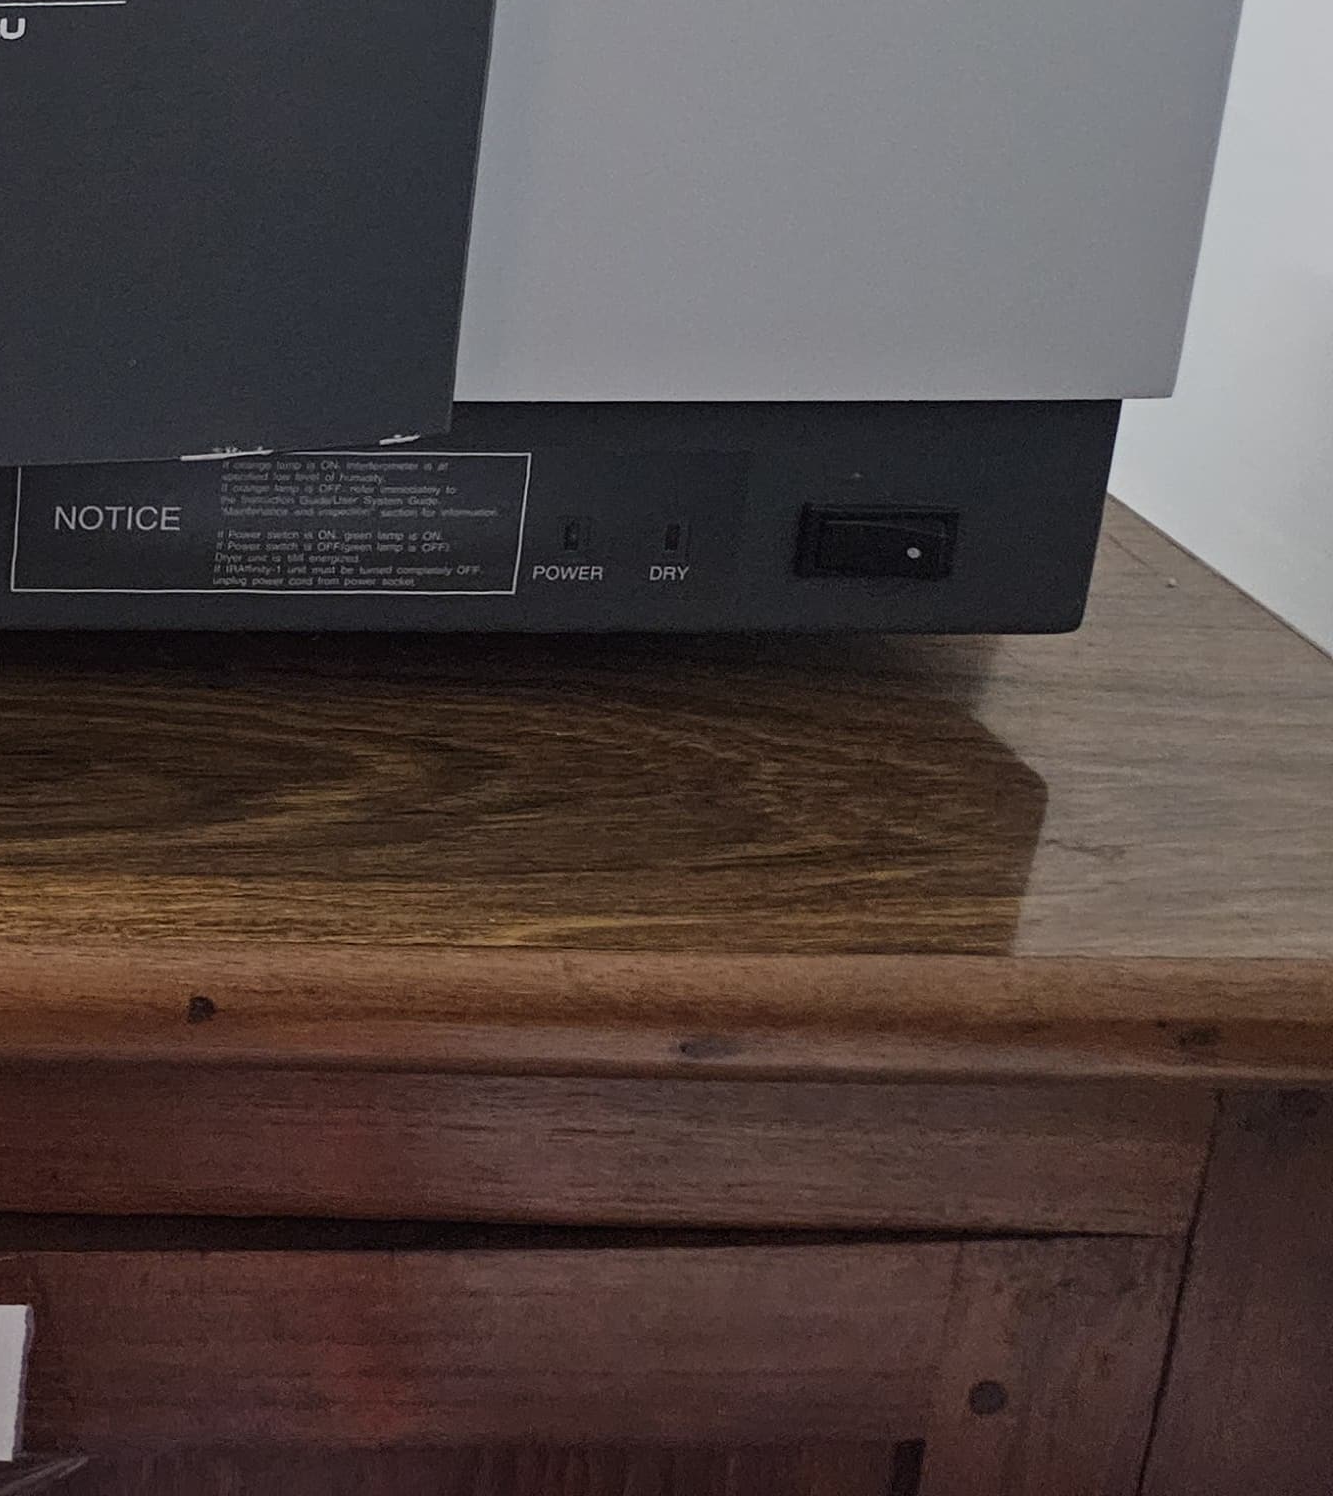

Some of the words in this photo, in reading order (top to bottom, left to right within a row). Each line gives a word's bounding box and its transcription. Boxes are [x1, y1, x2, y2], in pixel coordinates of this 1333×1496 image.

[54, 505, 182, 532] NOTICE
[228, 530, 261, 539] Power
[227, 542, 261, 551] Power
[532, 565, 604, 582] POWER
[649, 565, 690, 582] DRY
